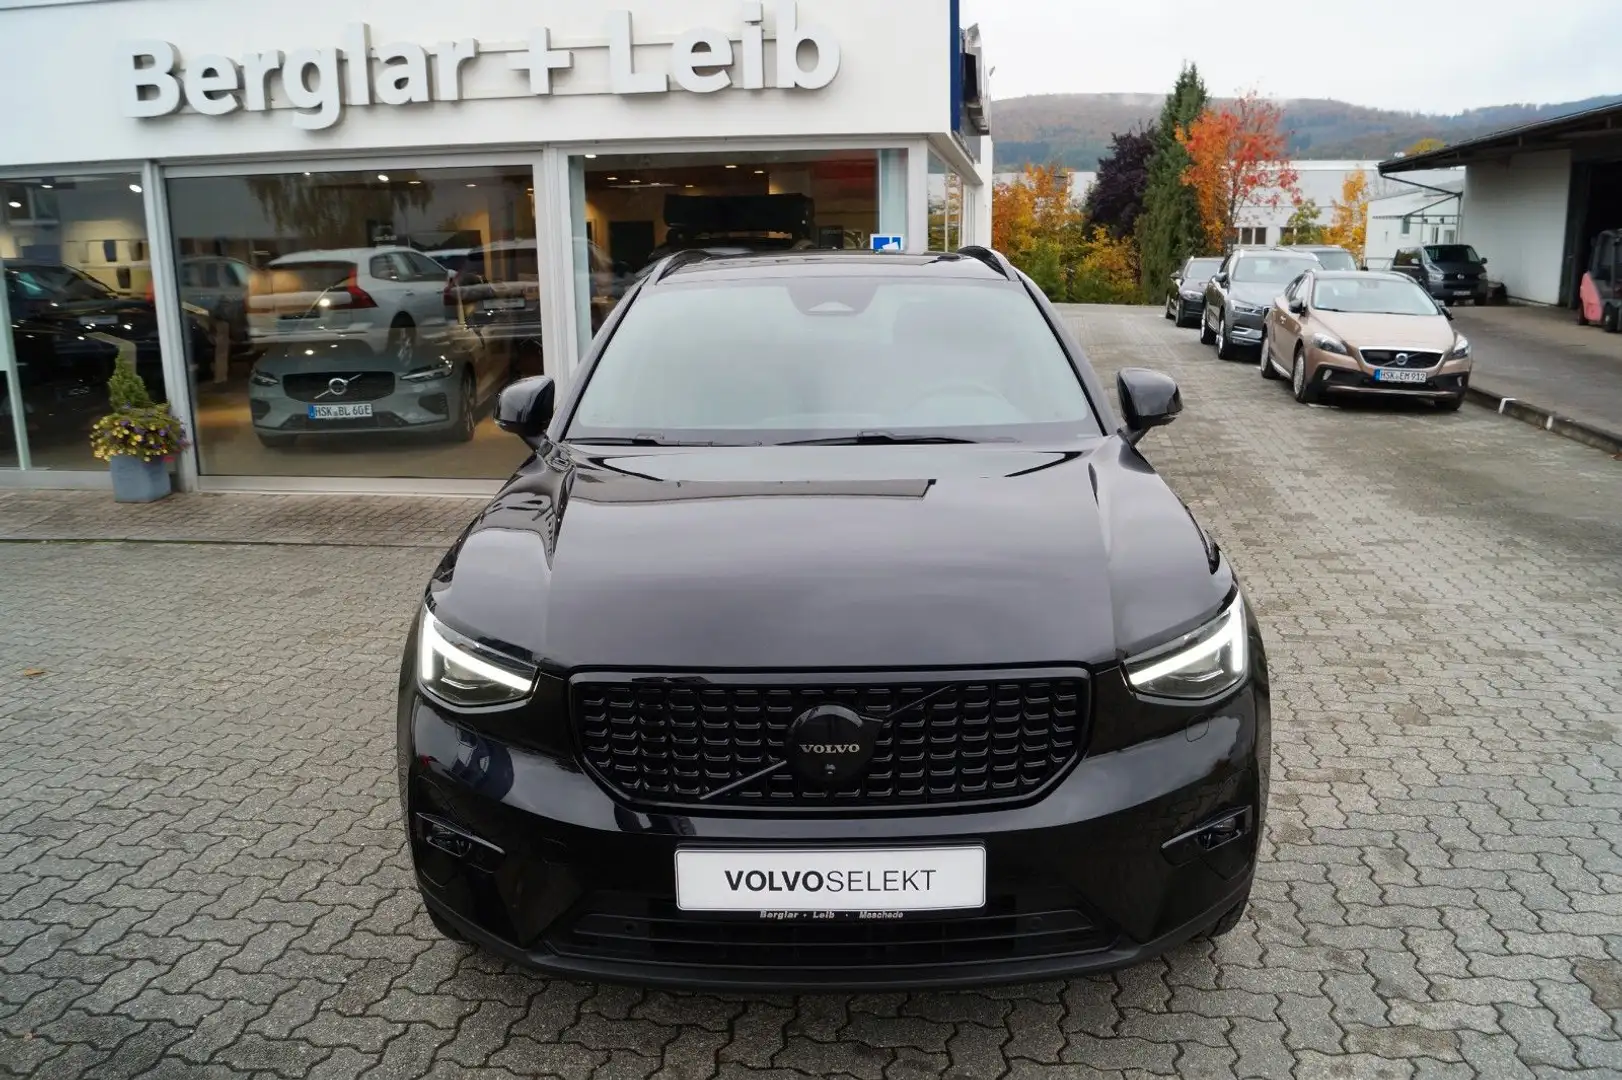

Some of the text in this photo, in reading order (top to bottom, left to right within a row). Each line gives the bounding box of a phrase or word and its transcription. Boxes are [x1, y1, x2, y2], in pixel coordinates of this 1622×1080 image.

[118, 0, 842, 131] Berglar + Leib
[799, 743, 860, 754] VOLVO
[724, 869, 937, 893] VOLVOSELEKT
[759, 910, 800, 920] Berglar
